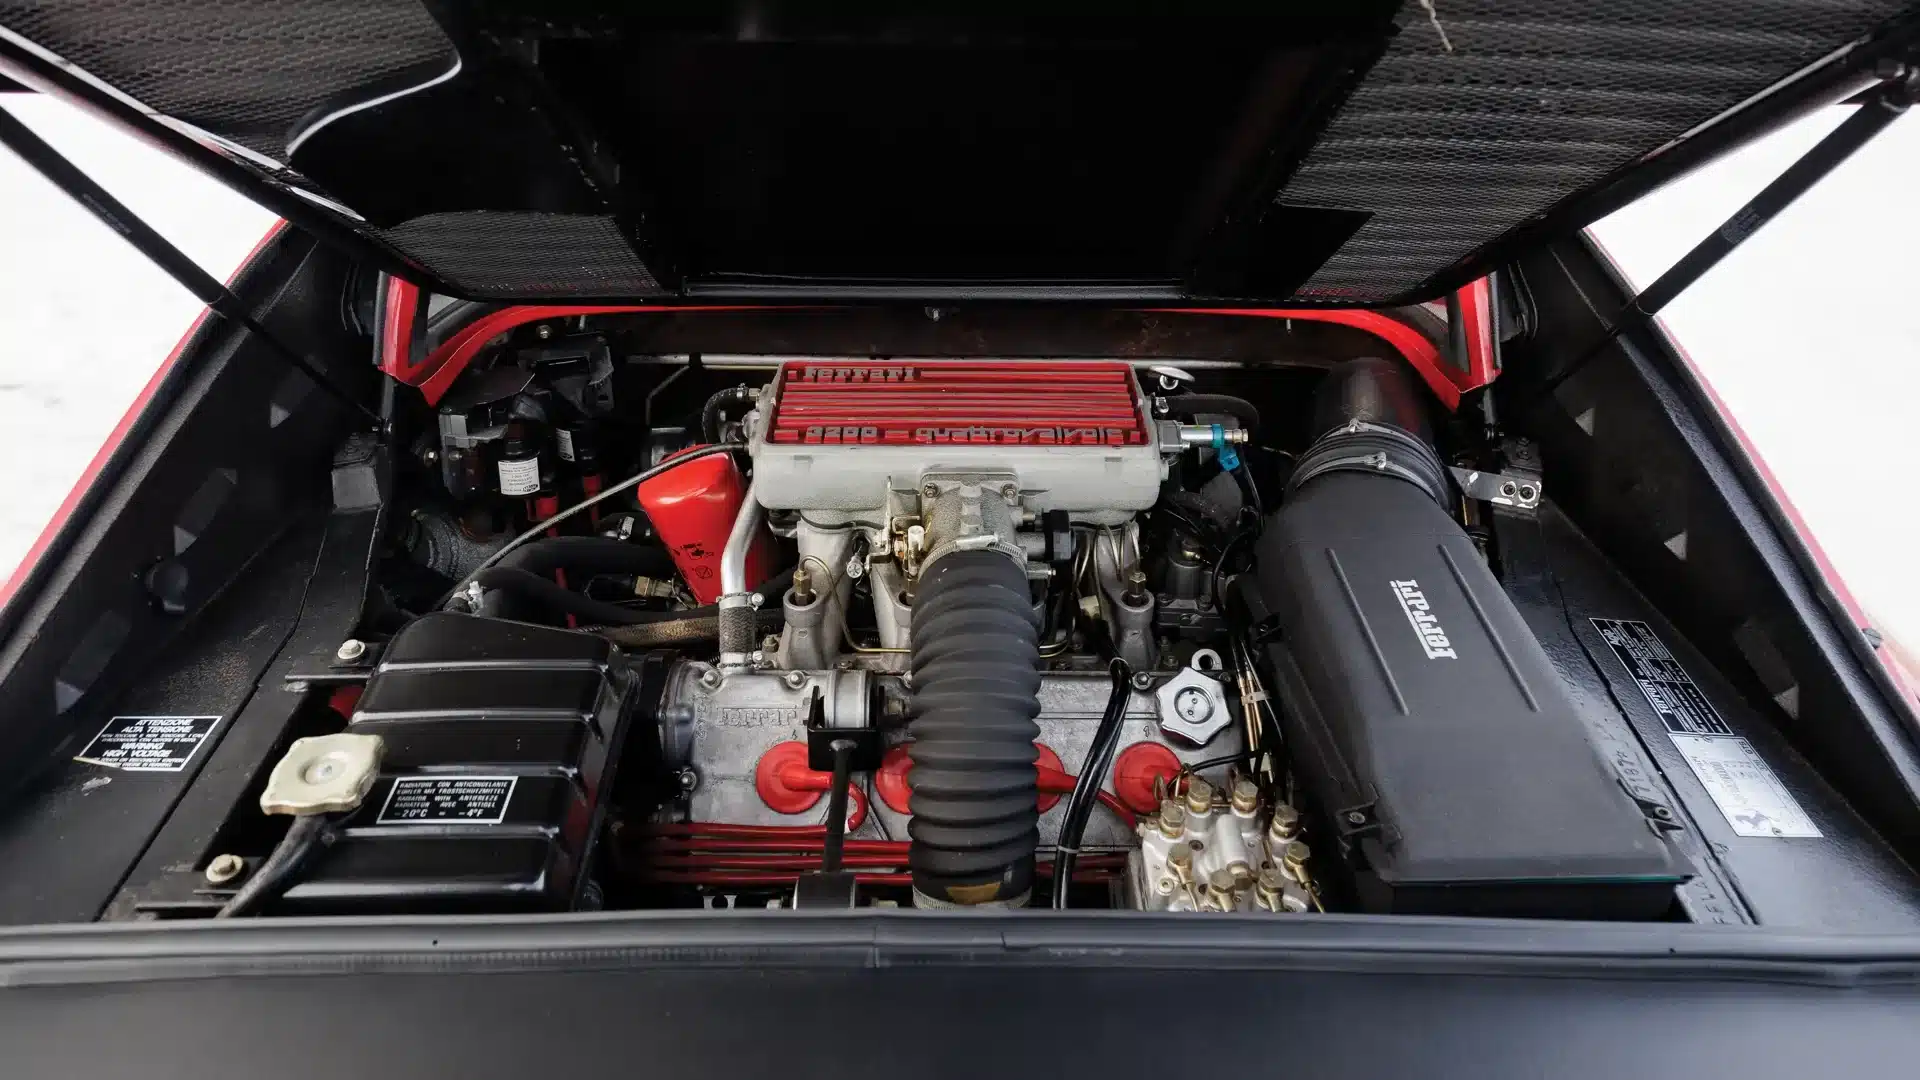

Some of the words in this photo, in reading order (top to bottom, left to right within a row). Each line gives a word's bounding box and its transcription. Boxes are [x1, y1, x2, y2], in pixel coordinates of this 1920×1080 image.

[804, 426, 878, 444] 3200
[915, 425, 1125, 445] quattrovalvole
[135, 718, 195, 726] ATTENZIONE
[120, 742, 166, 750] WARNING
[102, 749, 128, 757] HIGH
[130, 749, 173, 757] VOLTAGE
